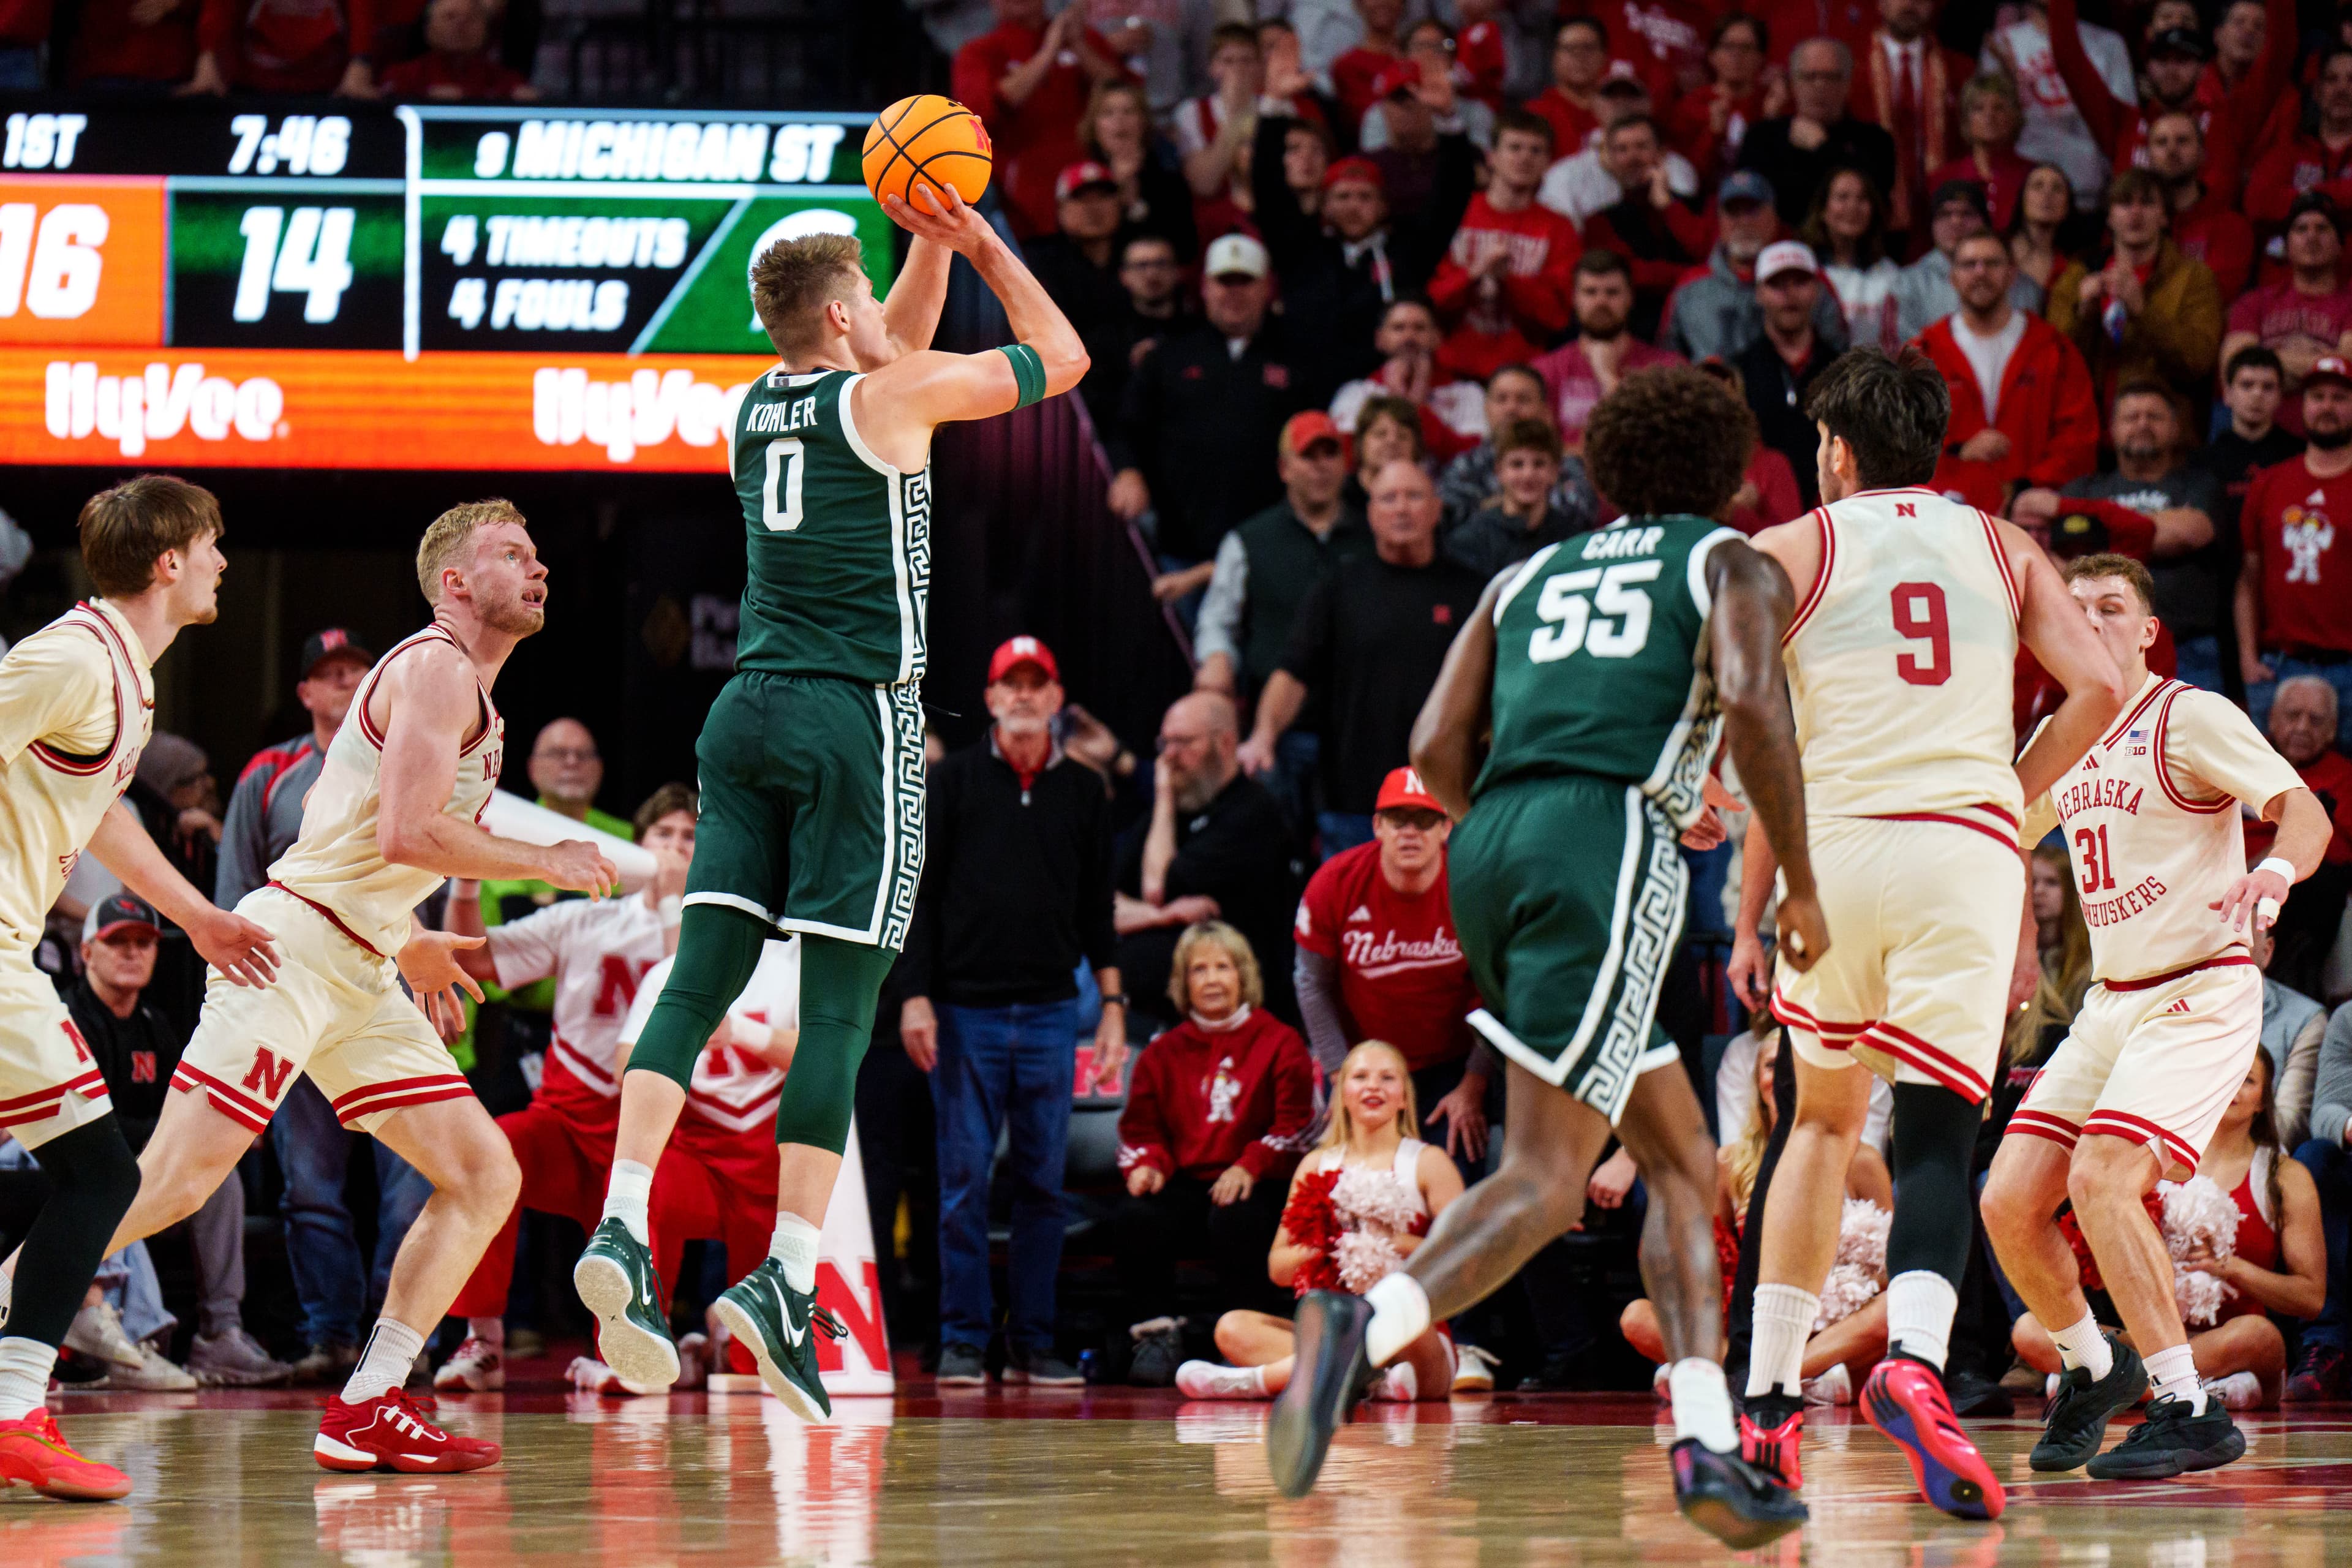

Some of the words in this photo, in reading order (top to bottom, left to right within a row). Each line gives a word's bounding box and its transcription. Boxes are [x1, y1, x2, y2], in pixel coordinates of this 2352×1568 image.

[3, 113, 88, 168] 1ST
[228, 115, 352, 175] 7:46
[512, 121, 769, 179] MICHIGAN
[769, 124, 846, 183] ST
[0, 203, 110, 318] 16
[233, 206, 355, 323] 14
[440, 215, 478, 266] 4
[486, 216, 690, 269] TIMEOUTS
[448, 278, 487, 330] 4
[491, 279, 630, 331] FOULS
[746, 396, 818, 432] KOHLER
[763, 437, 804, 532] 0
[1894, 503, 1917, 518] N
[1580, 526, 1665, 560] CARR
[1528, 560, 1664, 663] 55
[1891, 582, 1951, 685] 9
[1401, 767, 1426, 795] N
[2057, 778, 2144, 829] NEBRASKA
[2075, 824, 2116, 894] 31
[1343, 926, 1463, 969] Nebraska
[131, 1051, 157, 1084] N
[241, 1044, 296, 1103] N
[812, 1257, 893, 1374] N
